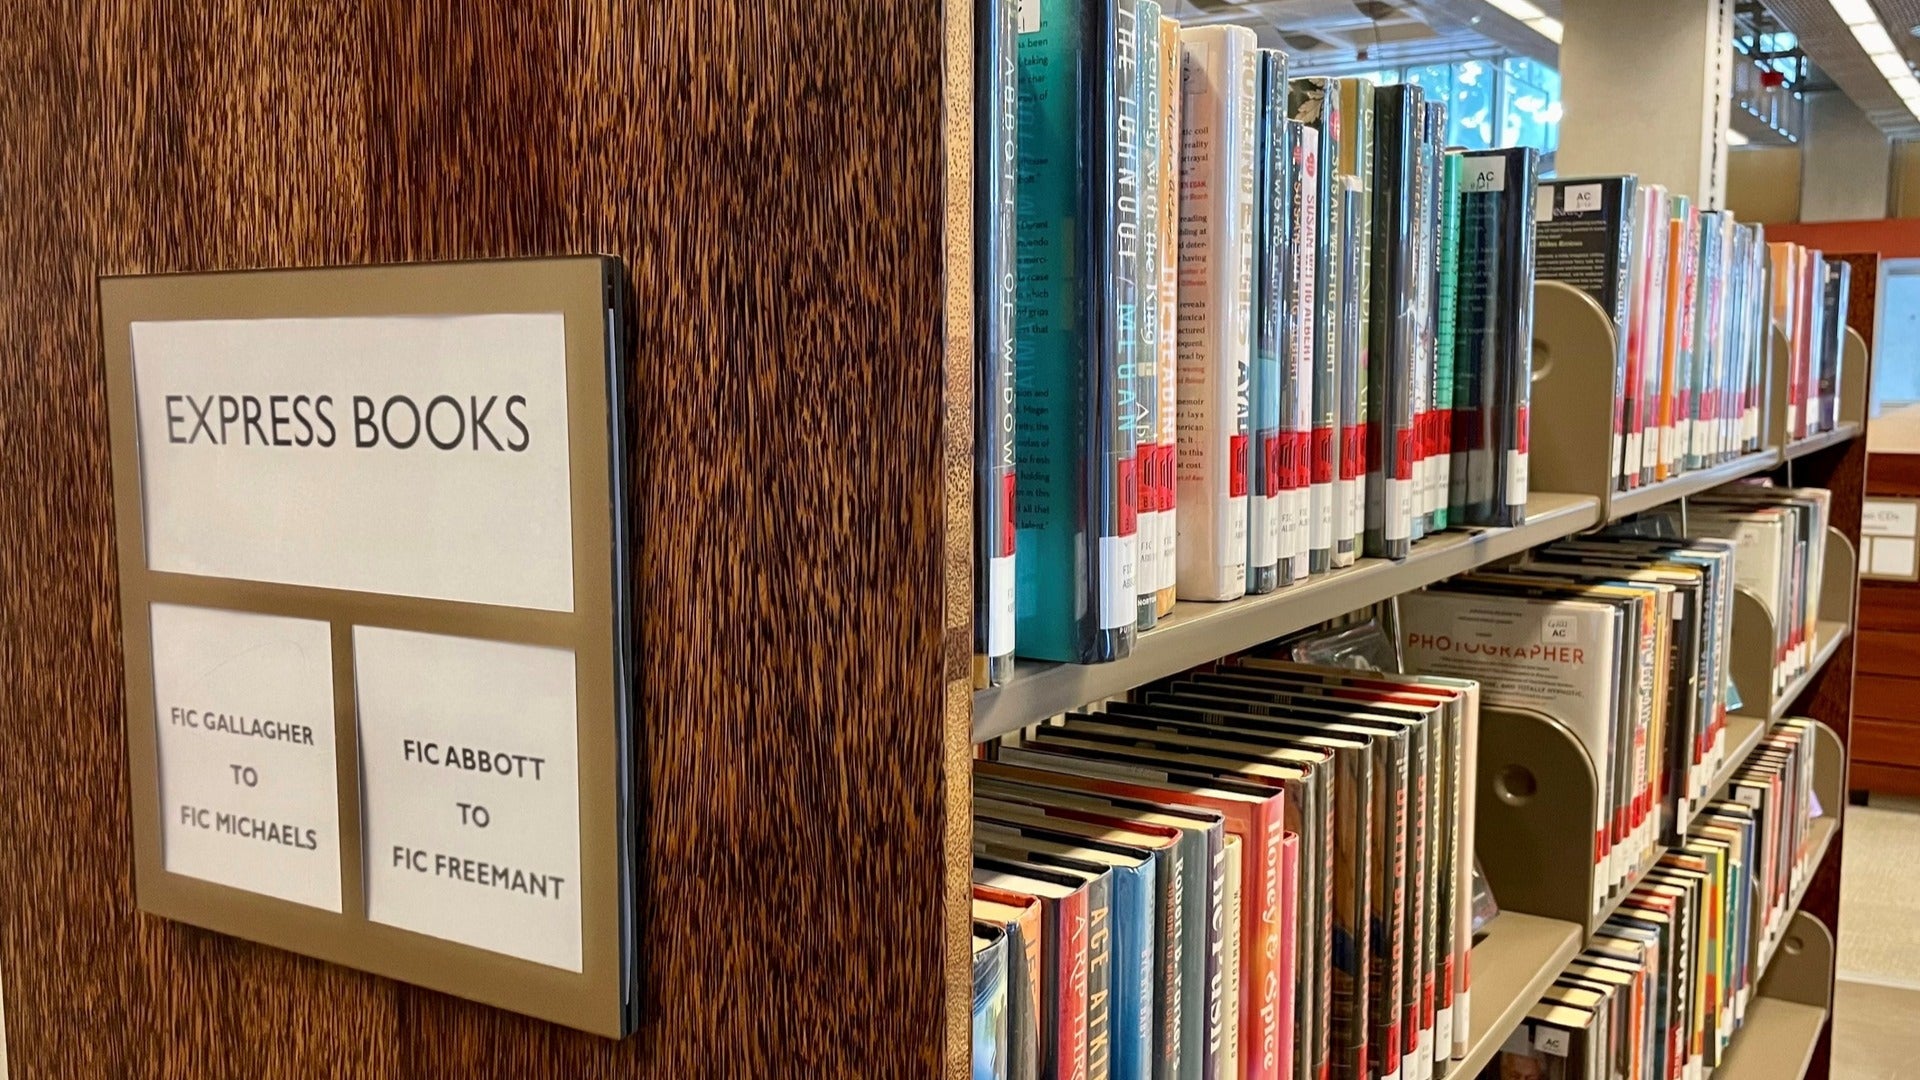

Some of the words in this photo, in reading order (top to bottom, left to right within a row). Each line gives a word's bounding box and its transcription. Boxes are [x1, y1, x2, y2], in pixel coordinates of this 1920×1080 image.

[1274, 136, 1282, 171] THE
[1477, 171, 1495, 182] AC
[1576, 192, 1591, 201] AC
[1305, 193, 1314, 249] SUSAN
[1160, 330, 1175, 444] READIN
[166, 395, 336, 447] EXPRESS
[353, 395, 530, 452] BOOKS
[1551, 629, 1567, 638] AC
[172, 708, 197, 727] FIC
[203, 712, 314, 745] GALLAGHER
[231, 765, 257, 786] TO
[404, 740, 439, 765] FIC
[446, 745, 545, 780] ABBOTT
[181, 806, 209, 829] FIC
[216, 812, 317, 850] MICHAELS
[457, 803, 490, 828] TO
[393, 846, 427, 873] FIC
[436, 855, 564, 899] FREEMANT
[1262, 818, 1282, 924] Honey
[1071, 915, 1085, 946] A
[1090, 906, 1108, 973] ACE
[1265, 934, 1279, 960] &
[1069, 948, 1085, 1000] RIP
[1260, 968, 1279, 1072] Spice
[1545, 1035, 1561, 1047] AC
